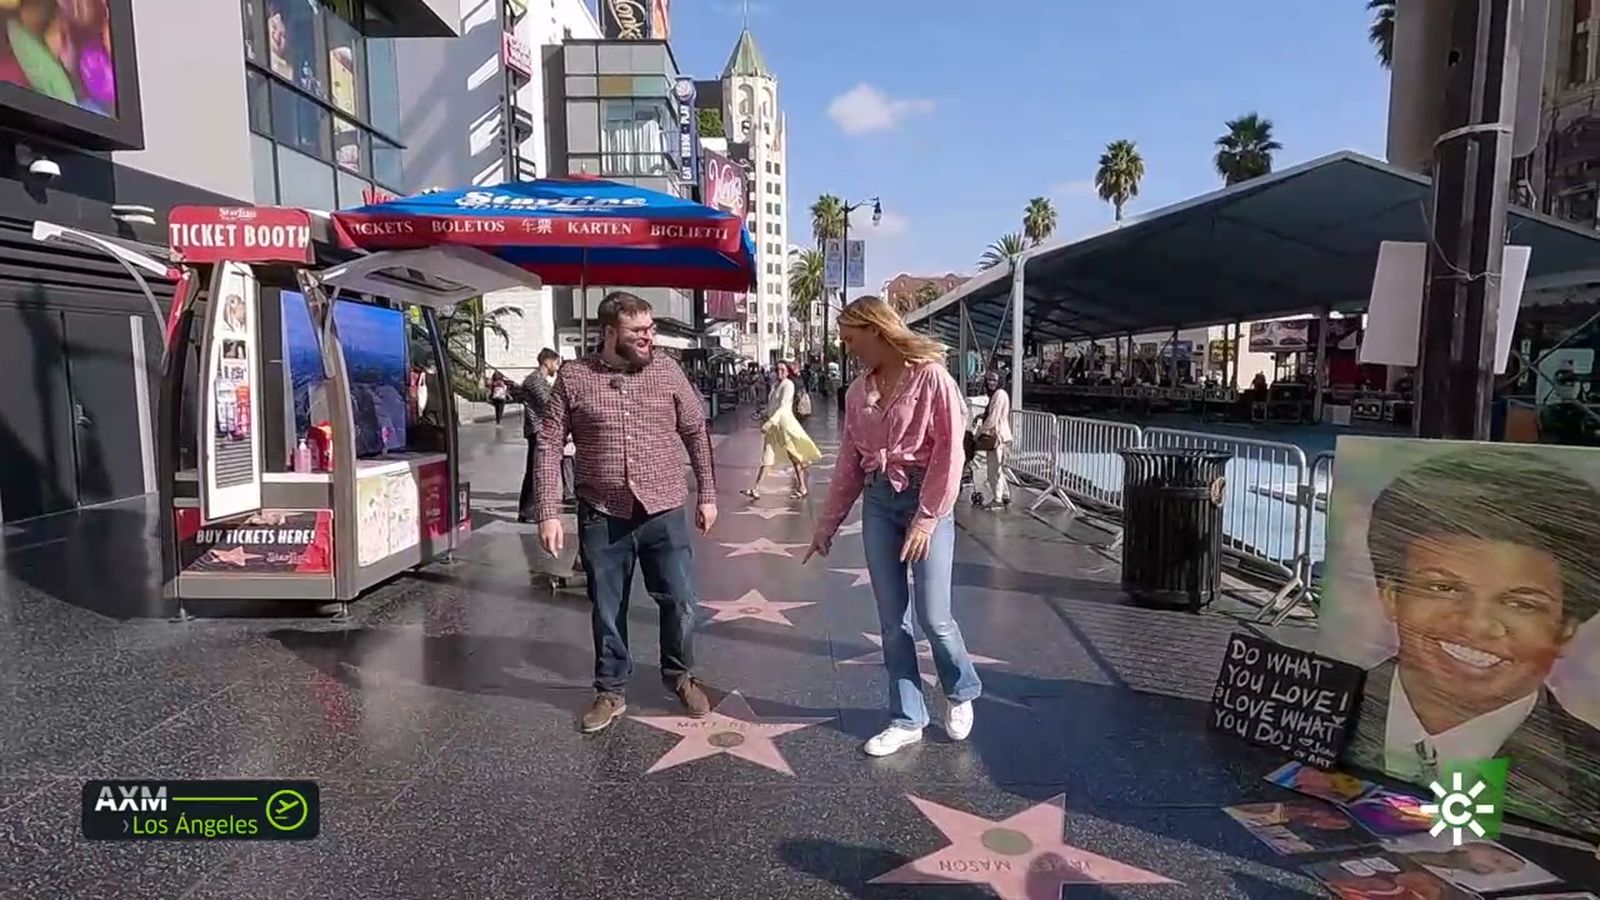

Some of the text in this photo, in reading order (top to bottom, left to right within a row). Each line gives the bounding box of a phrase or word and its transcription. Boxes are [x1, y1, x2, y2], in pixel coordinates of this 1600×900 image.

[170, 223, 310, 248] TICKET BOOTH
[432, 220, 505, 233] BOLETOS
[568, 221, 728, 241] KARTEN BIGLIETTI
[196, 529, 316, 544] BUY TICKETS HERE!
[1231, 640, 1333, 683] DO WHAT
[1228, 664, 1264, 693] YOU
[1215, 709, 1249, 737] YOU
[1281, 708, 1343, 742] WHAT
[938, 860, 1012, 872] MASON
